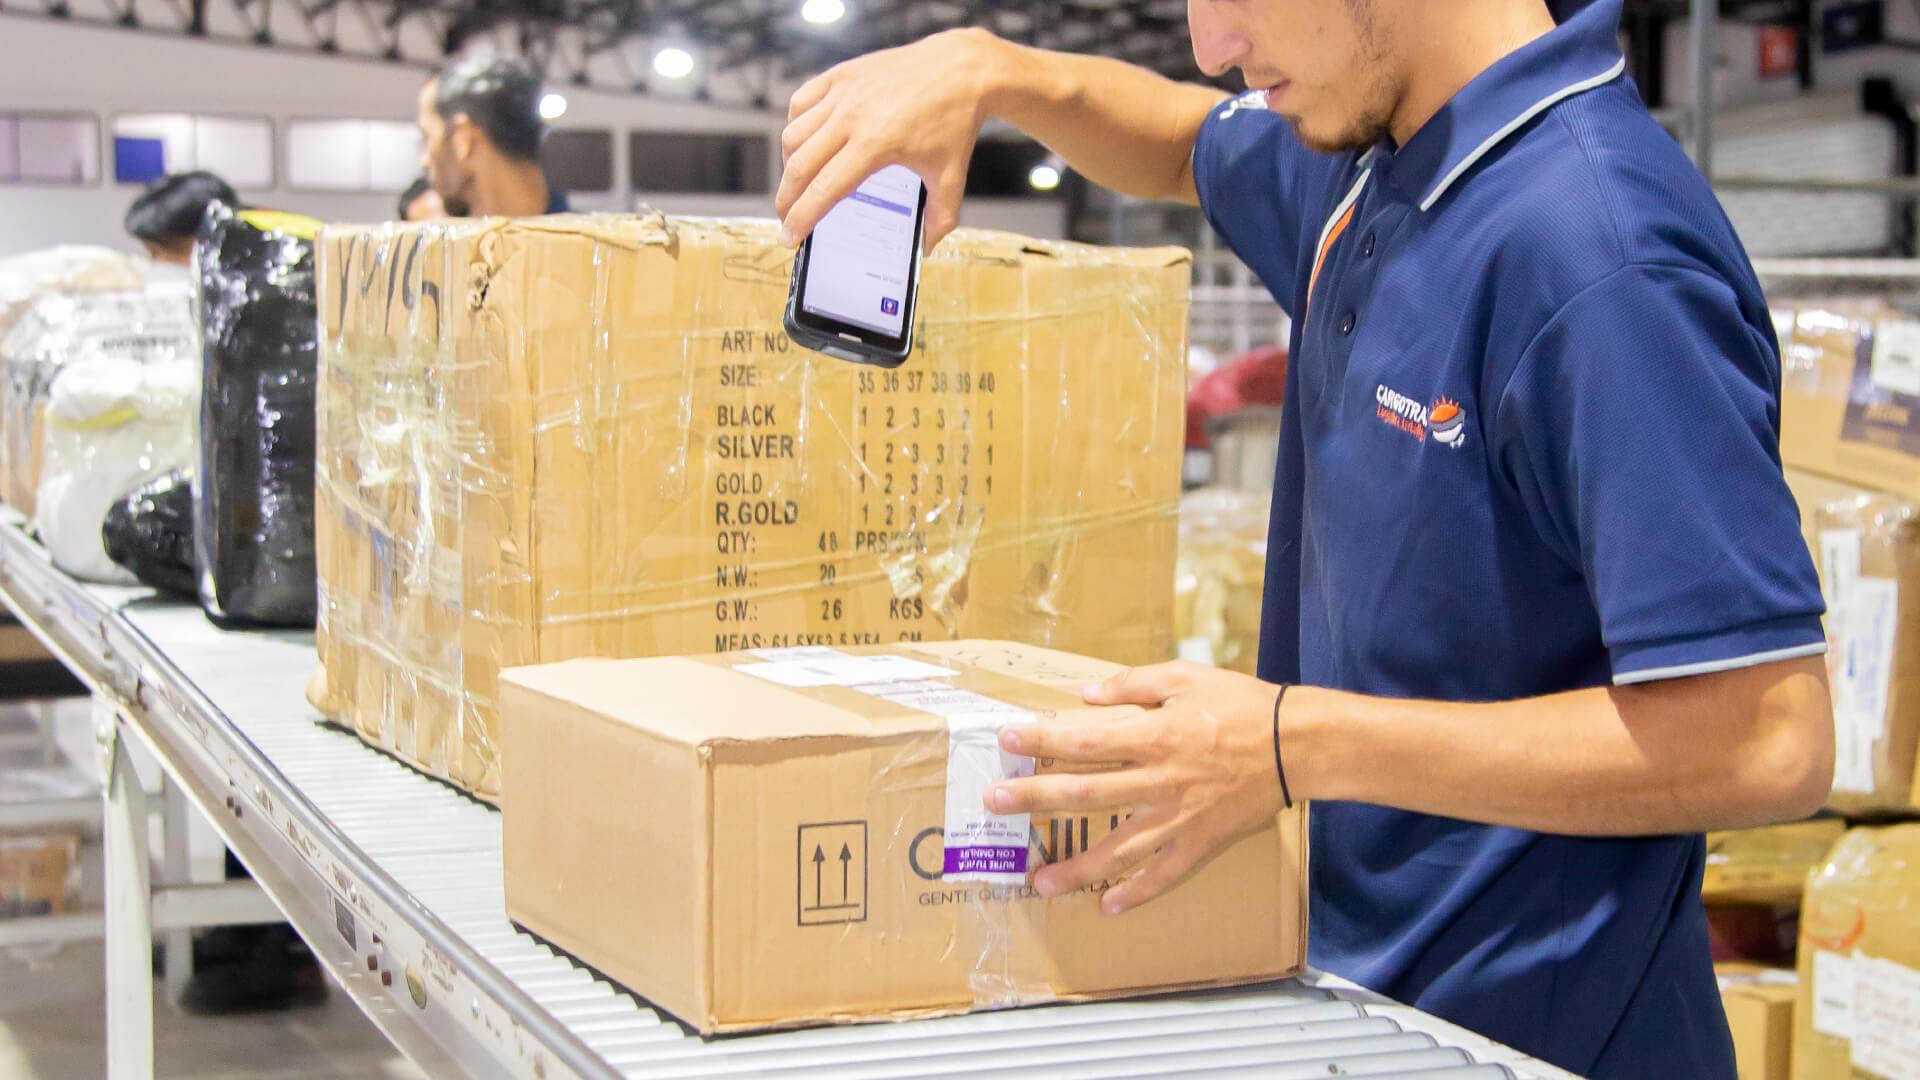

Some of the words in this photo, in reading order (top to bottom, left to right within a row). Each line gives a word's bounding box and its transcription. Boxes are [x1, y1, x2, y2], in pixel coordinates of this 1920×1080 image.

[721, 330, 755, 352] ART
[764, 330, 794, 352] NO.
[720, 365, 762, 386] SIZE:
[858, 370, 875, 393] 35
[882, 371, 899, 393] 36
[907, 370, 924, 393] 37
[931, 371, 948, 393] 38
[956, 371, 971, 394] 39
[978, 371, 995, 393] 40
[717, 404, 776, 427] BLACK
[861, 406, 868, 427] 1
[886, 406, 895, 428] 2
[912, 407, 920, 429] 3
[937, 407, 945, 429] 3
[987, 409, 994, 431] 1
[717, 434, 794, 459] SILVER
[860, 441, 867, 463] 1
[885, 442, 894, 464] 2
[911, 443, 919, 464] 3
[936, 443, 944, 465] 3
[962, 444, 970, 465] 2
[986, 444, 993, 466] 1
[716, 471, 762, 495] GOLD
[859, 472, 866, 494] 1
[884, 473, 893, 495] 2
[911, 473, 919, 495] 3
[935, 474, 944, 496] 3
[960, 474, 969, 496] 2
[985, 475, 992, 496] 1
[715, 500, 799, 527] R.GOLD
[862, 503, 869, 525] 1
[885, 504, 894, 526] 2
[717, 531, 756, 553] QTY:
[818, 530, 838, 553] 48
[716, 565, 759, 588] N.W.:
[819, 563, 836, 586] 20
[716, 599, 758, 622] G.W.:
[821, 598, 842, 622] 26
[889, 597, 923, 620] KGS
[715, 633, 767, 653] MEAS:
[975, 860, 988, 871] TU
[988, 860, 1016, 871] NUTRE
[996, 848, 1016, 859] CON
[918, 887, 974, 906] GENTE
